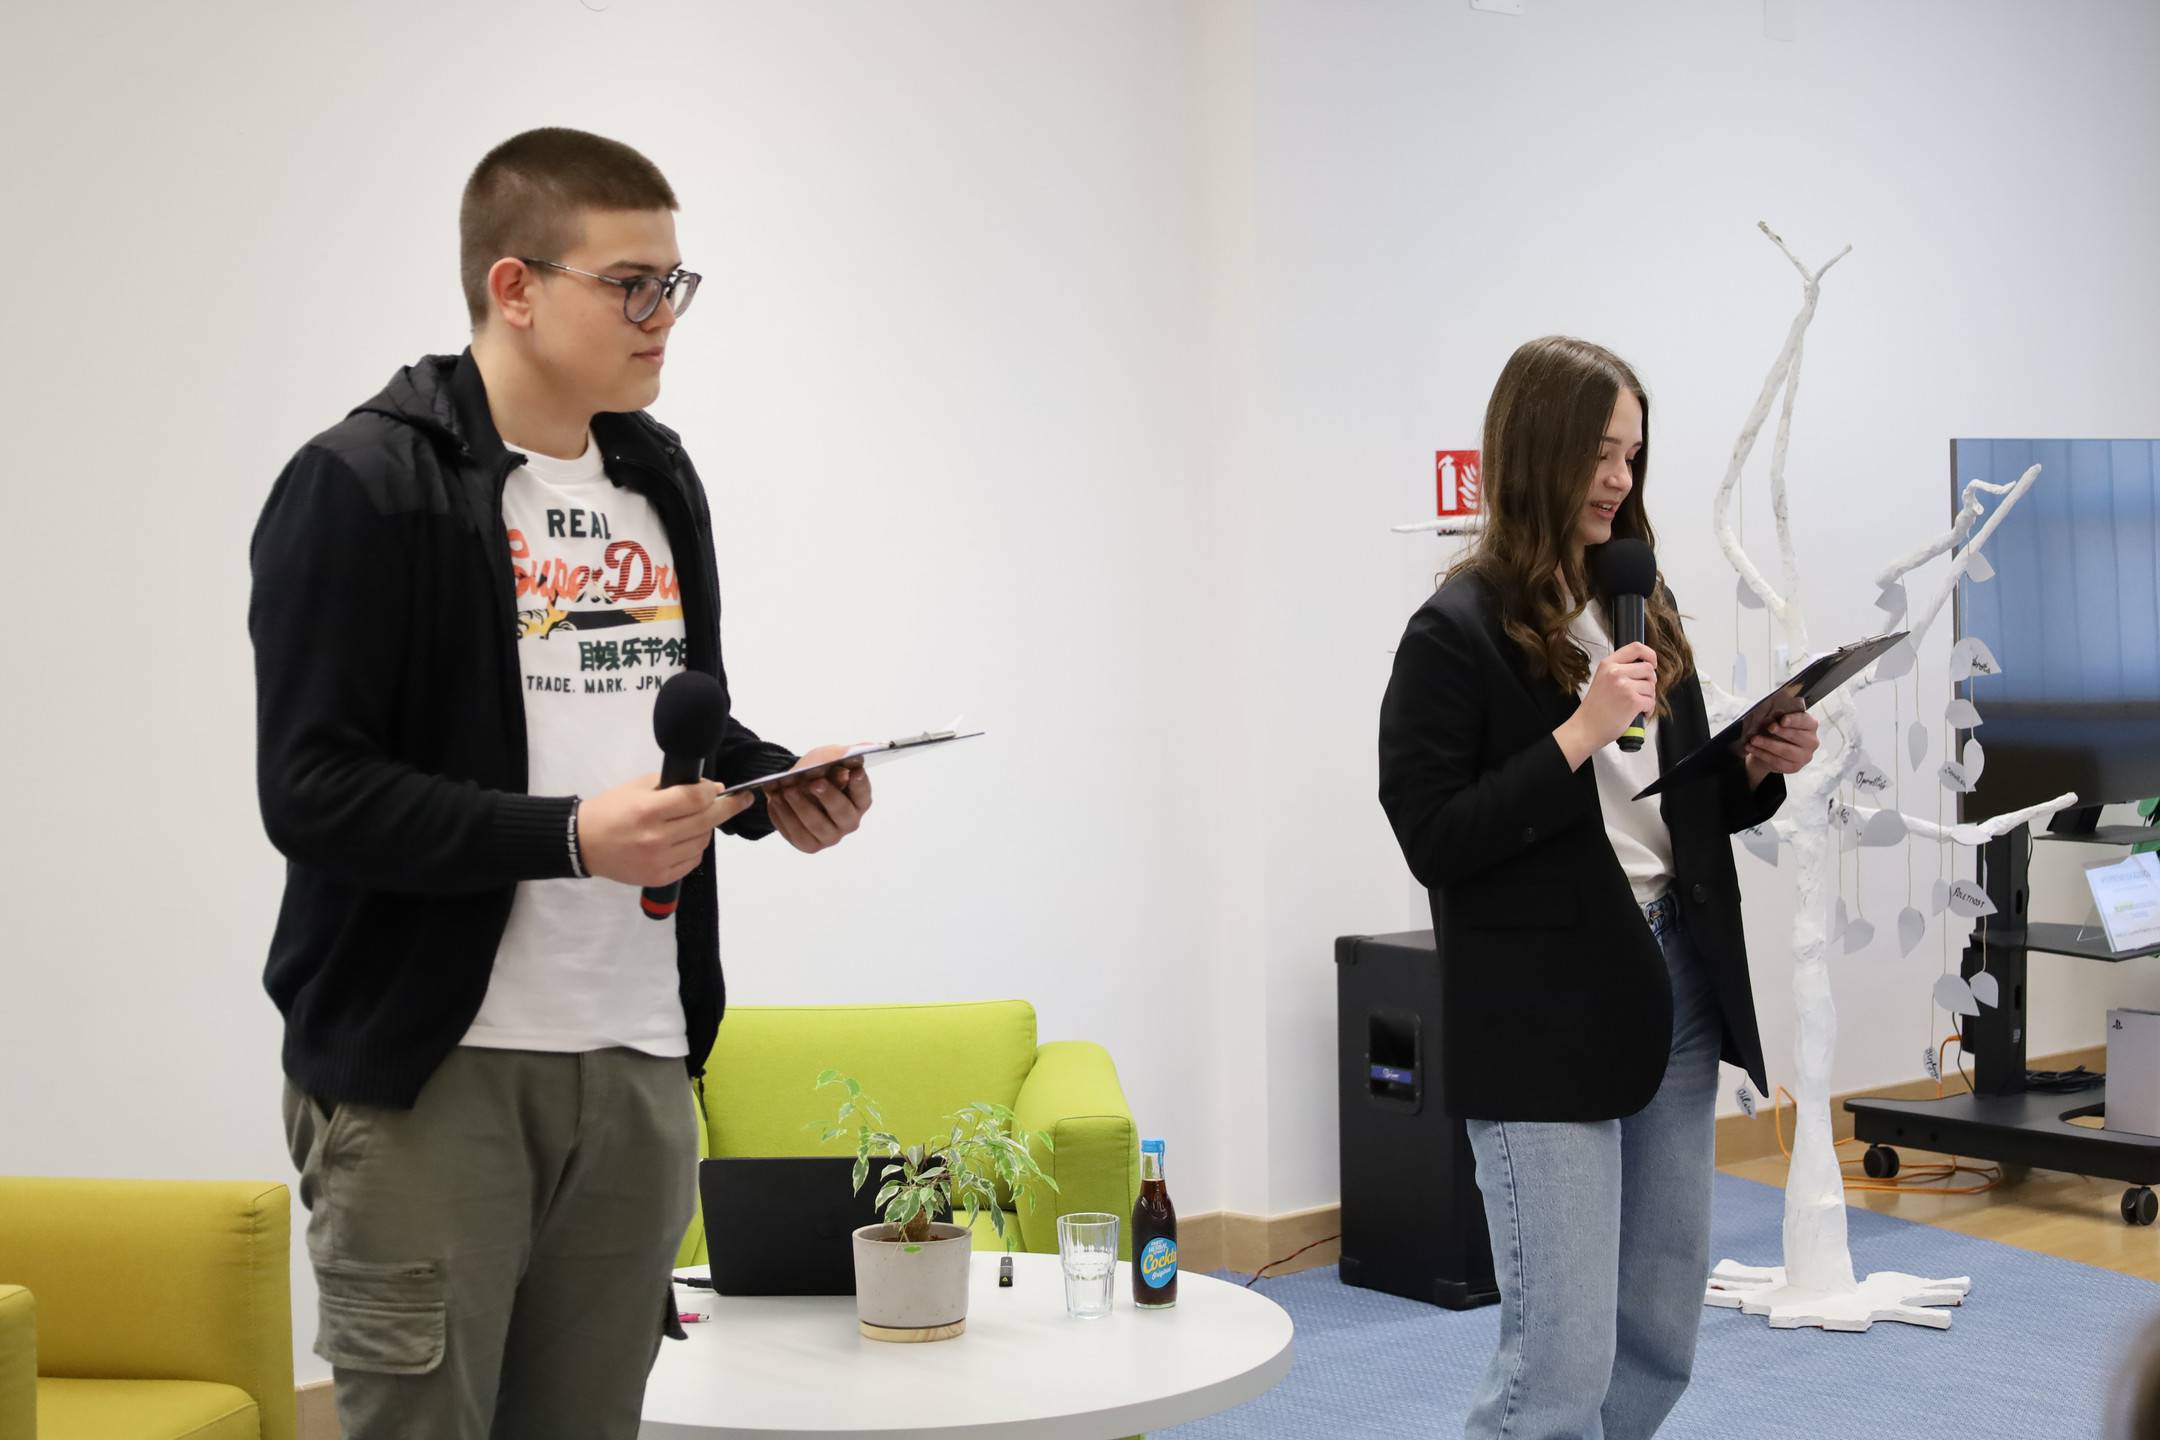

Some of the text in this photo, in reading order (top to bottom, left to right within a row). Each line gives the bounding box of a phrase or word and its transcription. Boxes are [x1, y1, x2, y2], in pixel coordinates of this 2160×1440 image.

[546, 508, 612, 539] REAL
[526, 675, 576, 693] TRADE.
[584, 677, 627, 694] MARK.
